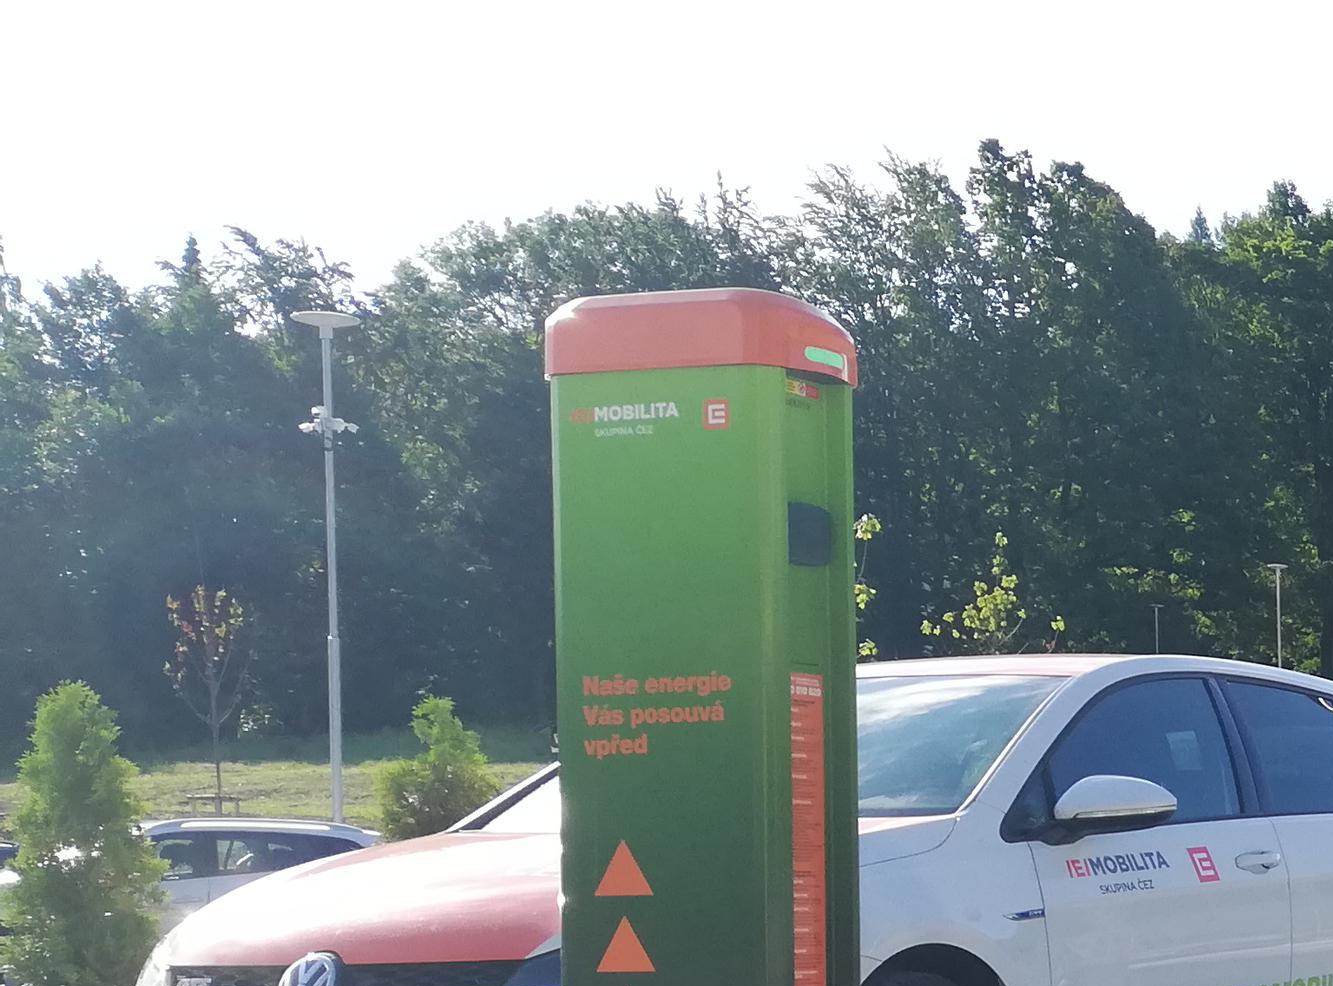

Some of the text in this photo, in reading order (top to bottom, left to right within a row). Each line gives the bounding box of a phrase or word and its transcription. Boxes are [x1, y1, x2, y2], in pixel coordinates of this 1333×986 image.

[582, 670, 733, 696] Naše energie
[583, 699, 725, 729] Vás posouvá
[584, 733, 648, 760] vpřed
[1100, 878, 1155, 895] SKUPINA ČEZ
